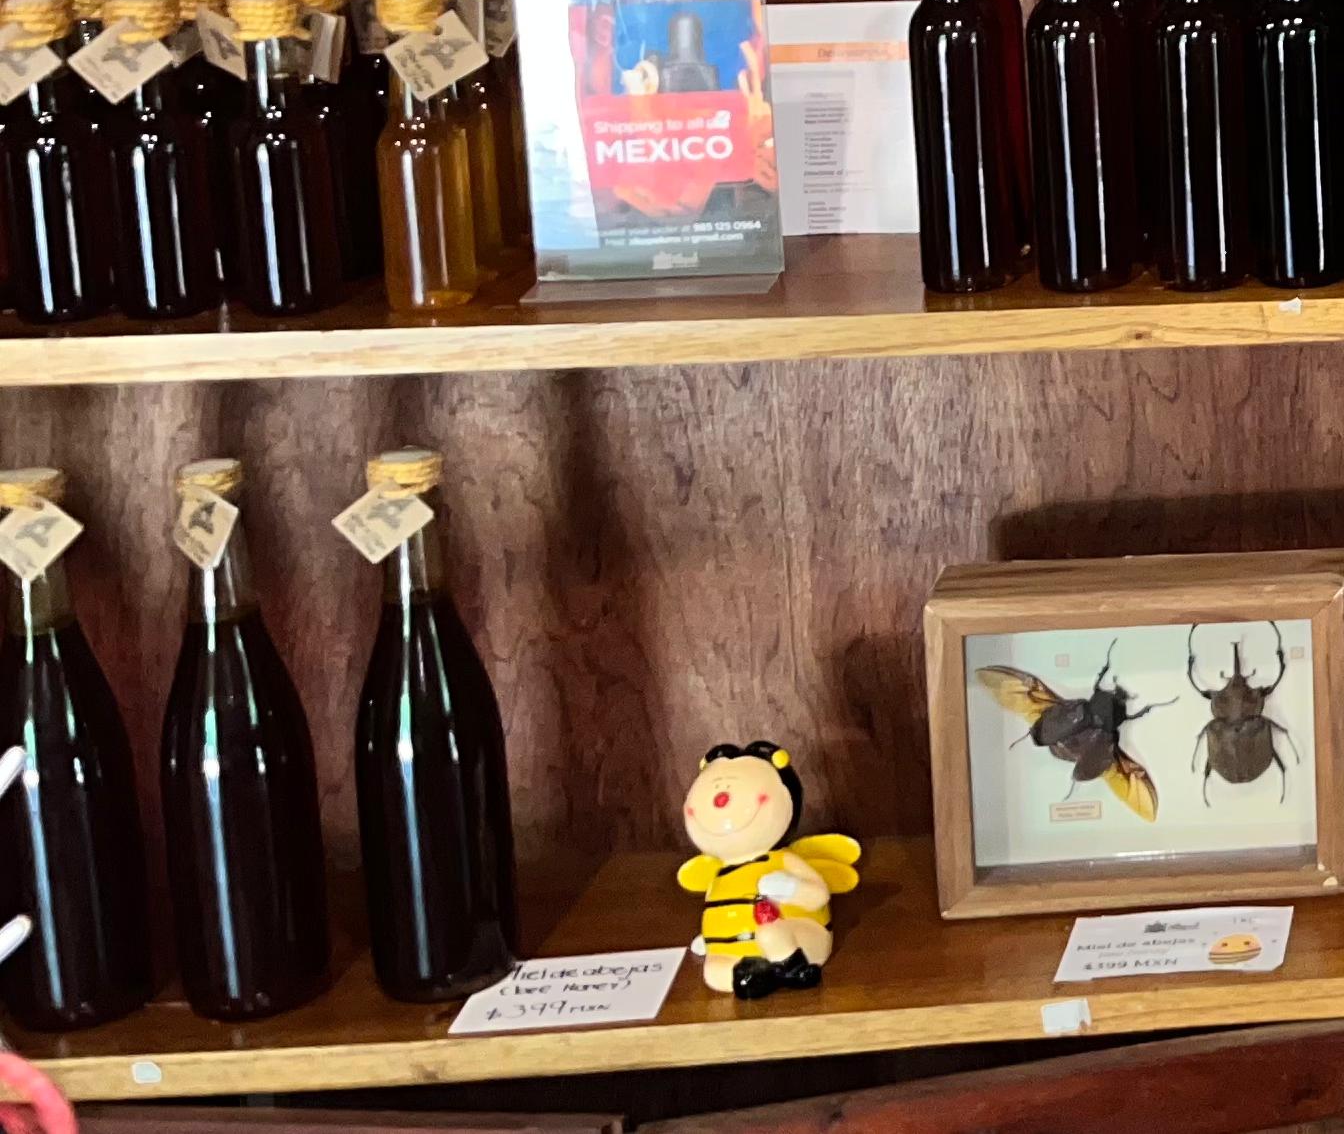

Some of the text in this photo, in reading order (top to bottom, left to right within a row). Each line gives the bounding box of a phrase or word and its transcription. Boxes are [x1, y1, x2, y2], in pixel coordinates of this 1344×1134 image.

[593, 121, 663, 135] Shipping
[666, 119, 682, 131] to
[594, 135, 734, 164] MEXICO
[1134, 958, 1178, 968] MXN
